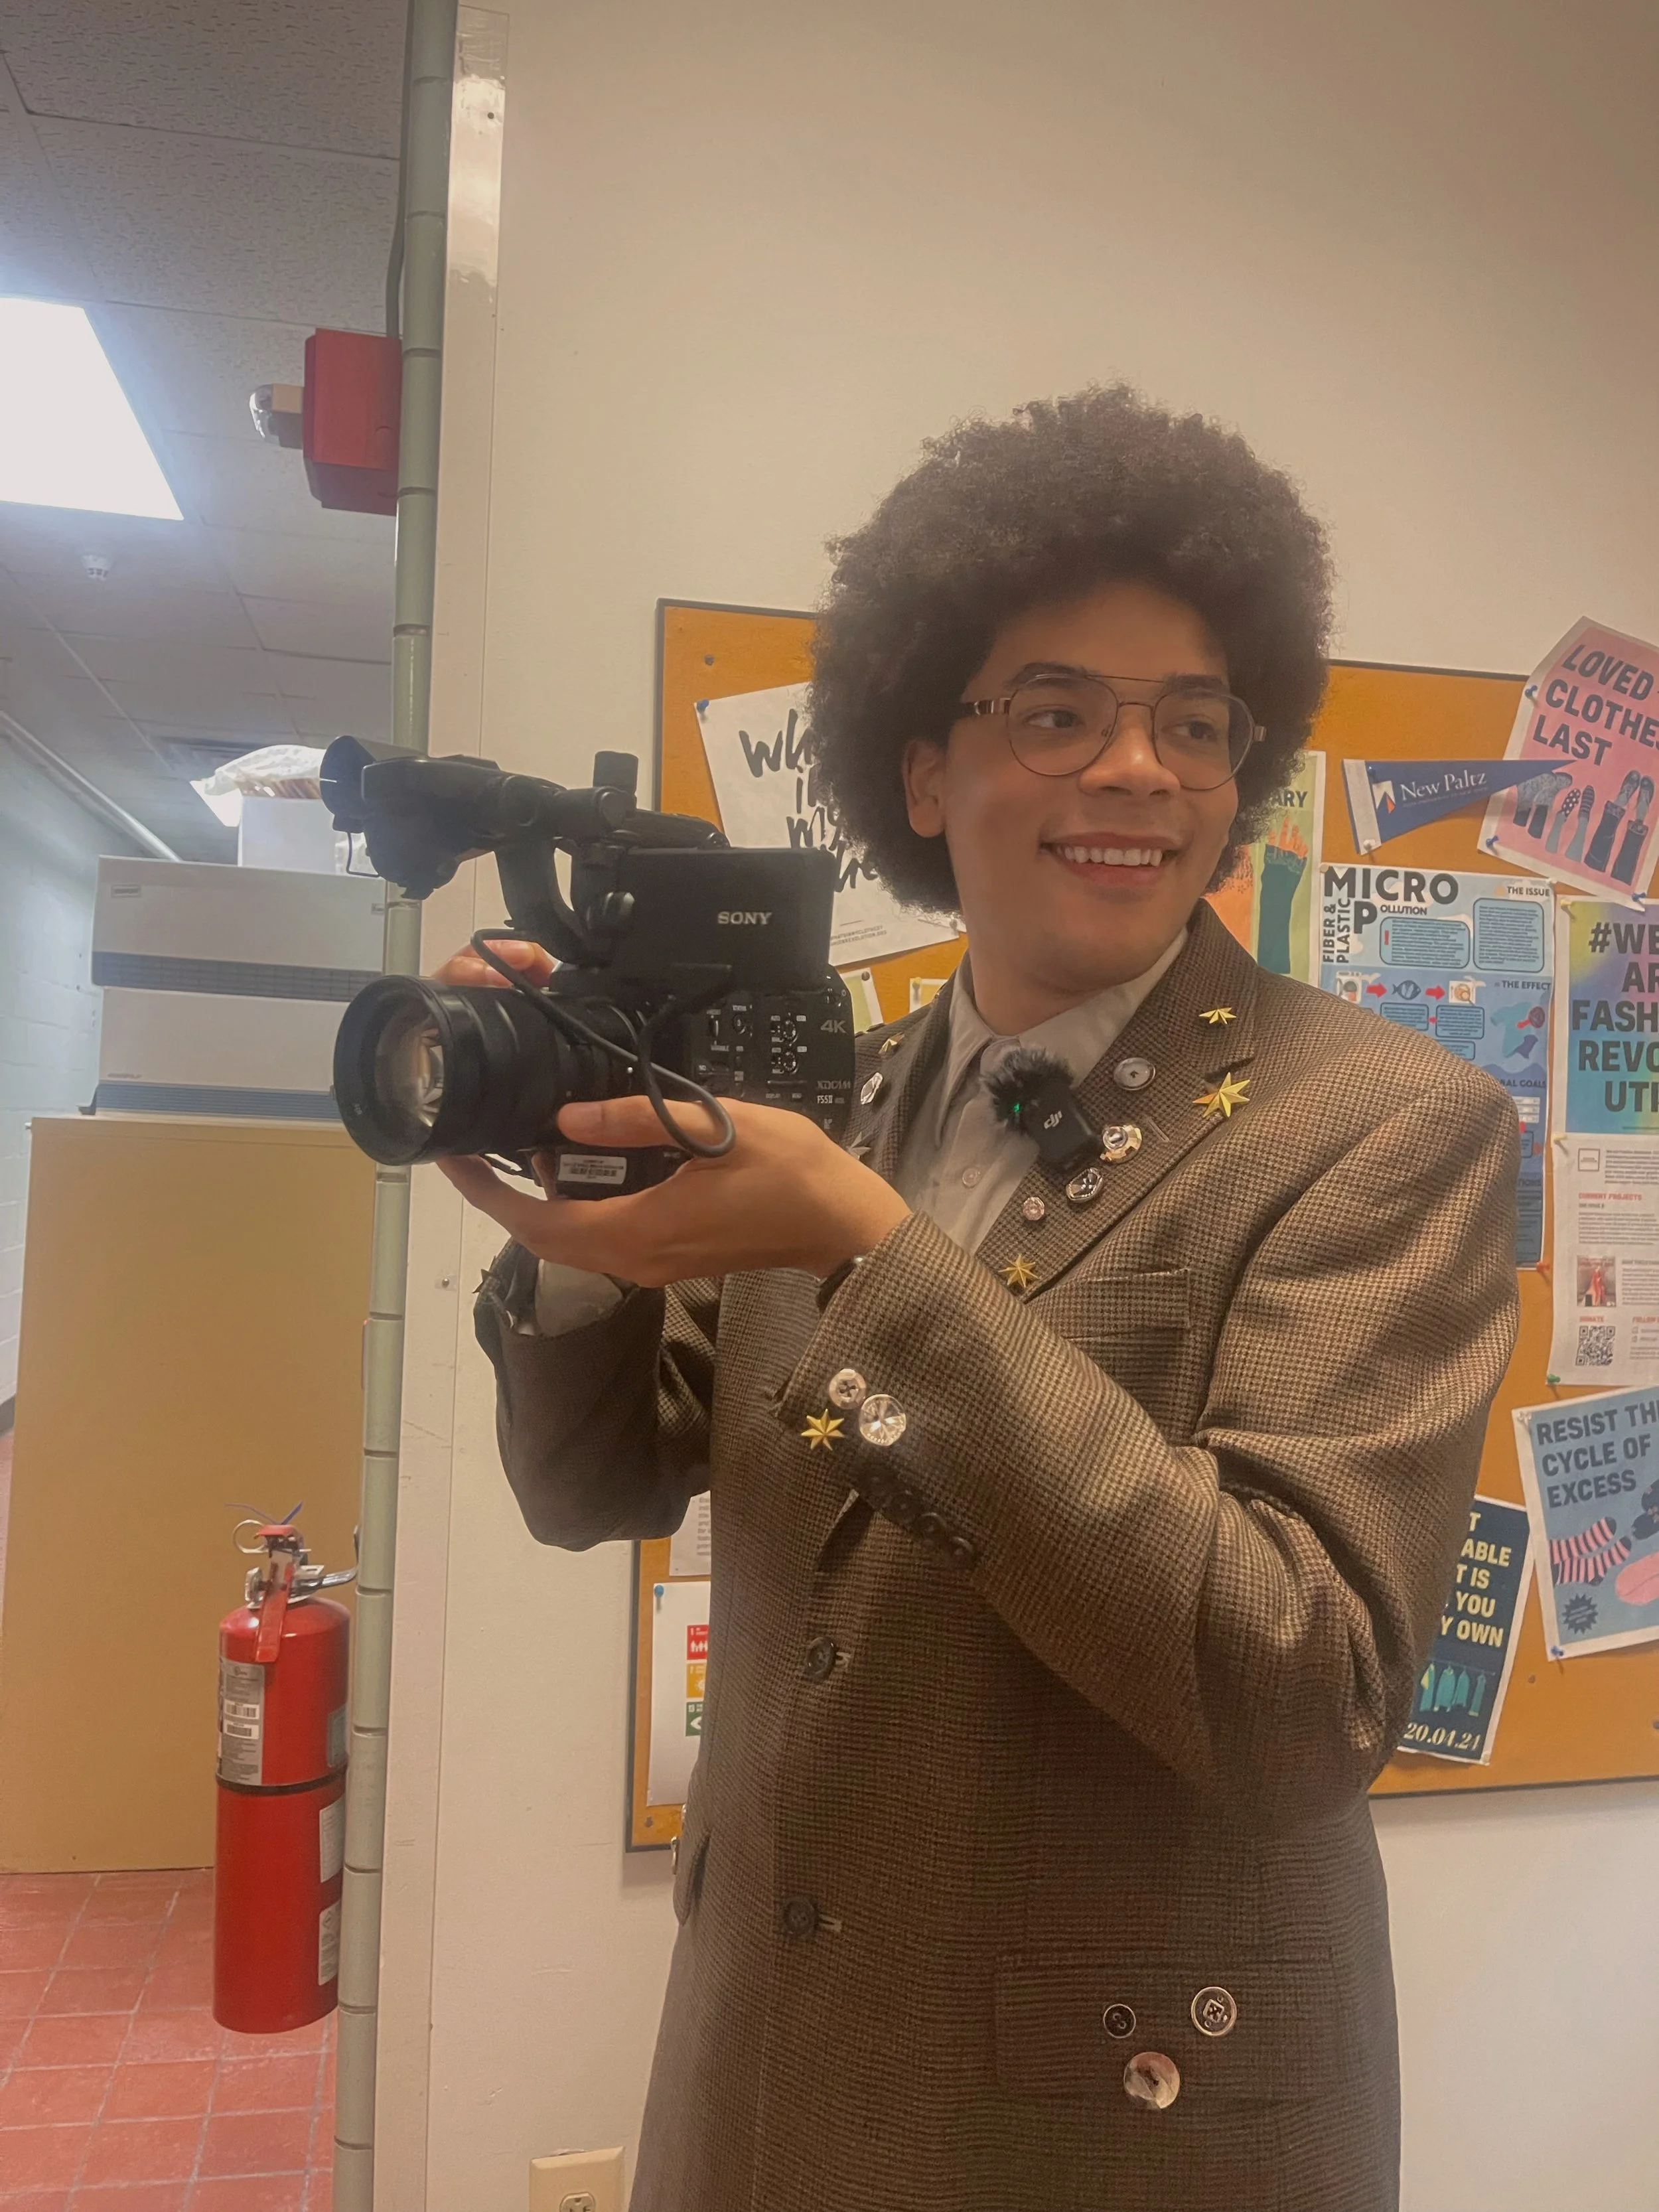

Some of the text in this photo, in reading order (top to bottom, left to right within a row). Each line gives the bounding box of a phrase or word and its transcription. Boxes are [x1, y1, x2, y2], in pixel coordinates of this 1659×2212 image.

[1561, 644, 1654, 701] LOVED
[1546, 679, 1659, 751] CLOTHE
[1533, 714, 1613, 766] LAST
[1400, 781, 1440, 801] New
[1444, 769, 1487, 792] Paltz
[1324, 865, 1459, 905] MICRO
[1507, 886, 1551, 897] THE ISSUE
[718, 911, 773, 925] SONY
[1323, 903, 1336, 964] FIBER &
[1336, 899, 1352, 964] PLASTIC
[1502, 980, 1551, 992] THE EFFECT
[820, 1019, 847, 1033] 4K
[1571, 999, 1659, 1034] FASH
[1578, 1039, 1659, 1074] REVO
[1604, 1080, 1659, 1113] UTI
[1536, 1400, 1659, 1445] RESIST TH
[1542, 1433, 1651, 1477] CYCLE OF
[1547, 1469, 1636, 1509] EXCESS
[1461, 1538, 1512, 1568] ABLE
[1469, 1566, 1490, 1590] IS
[1455, 1589, 1496, 1619] YOU
[1456, 1619, 1504, 1649] OWN
